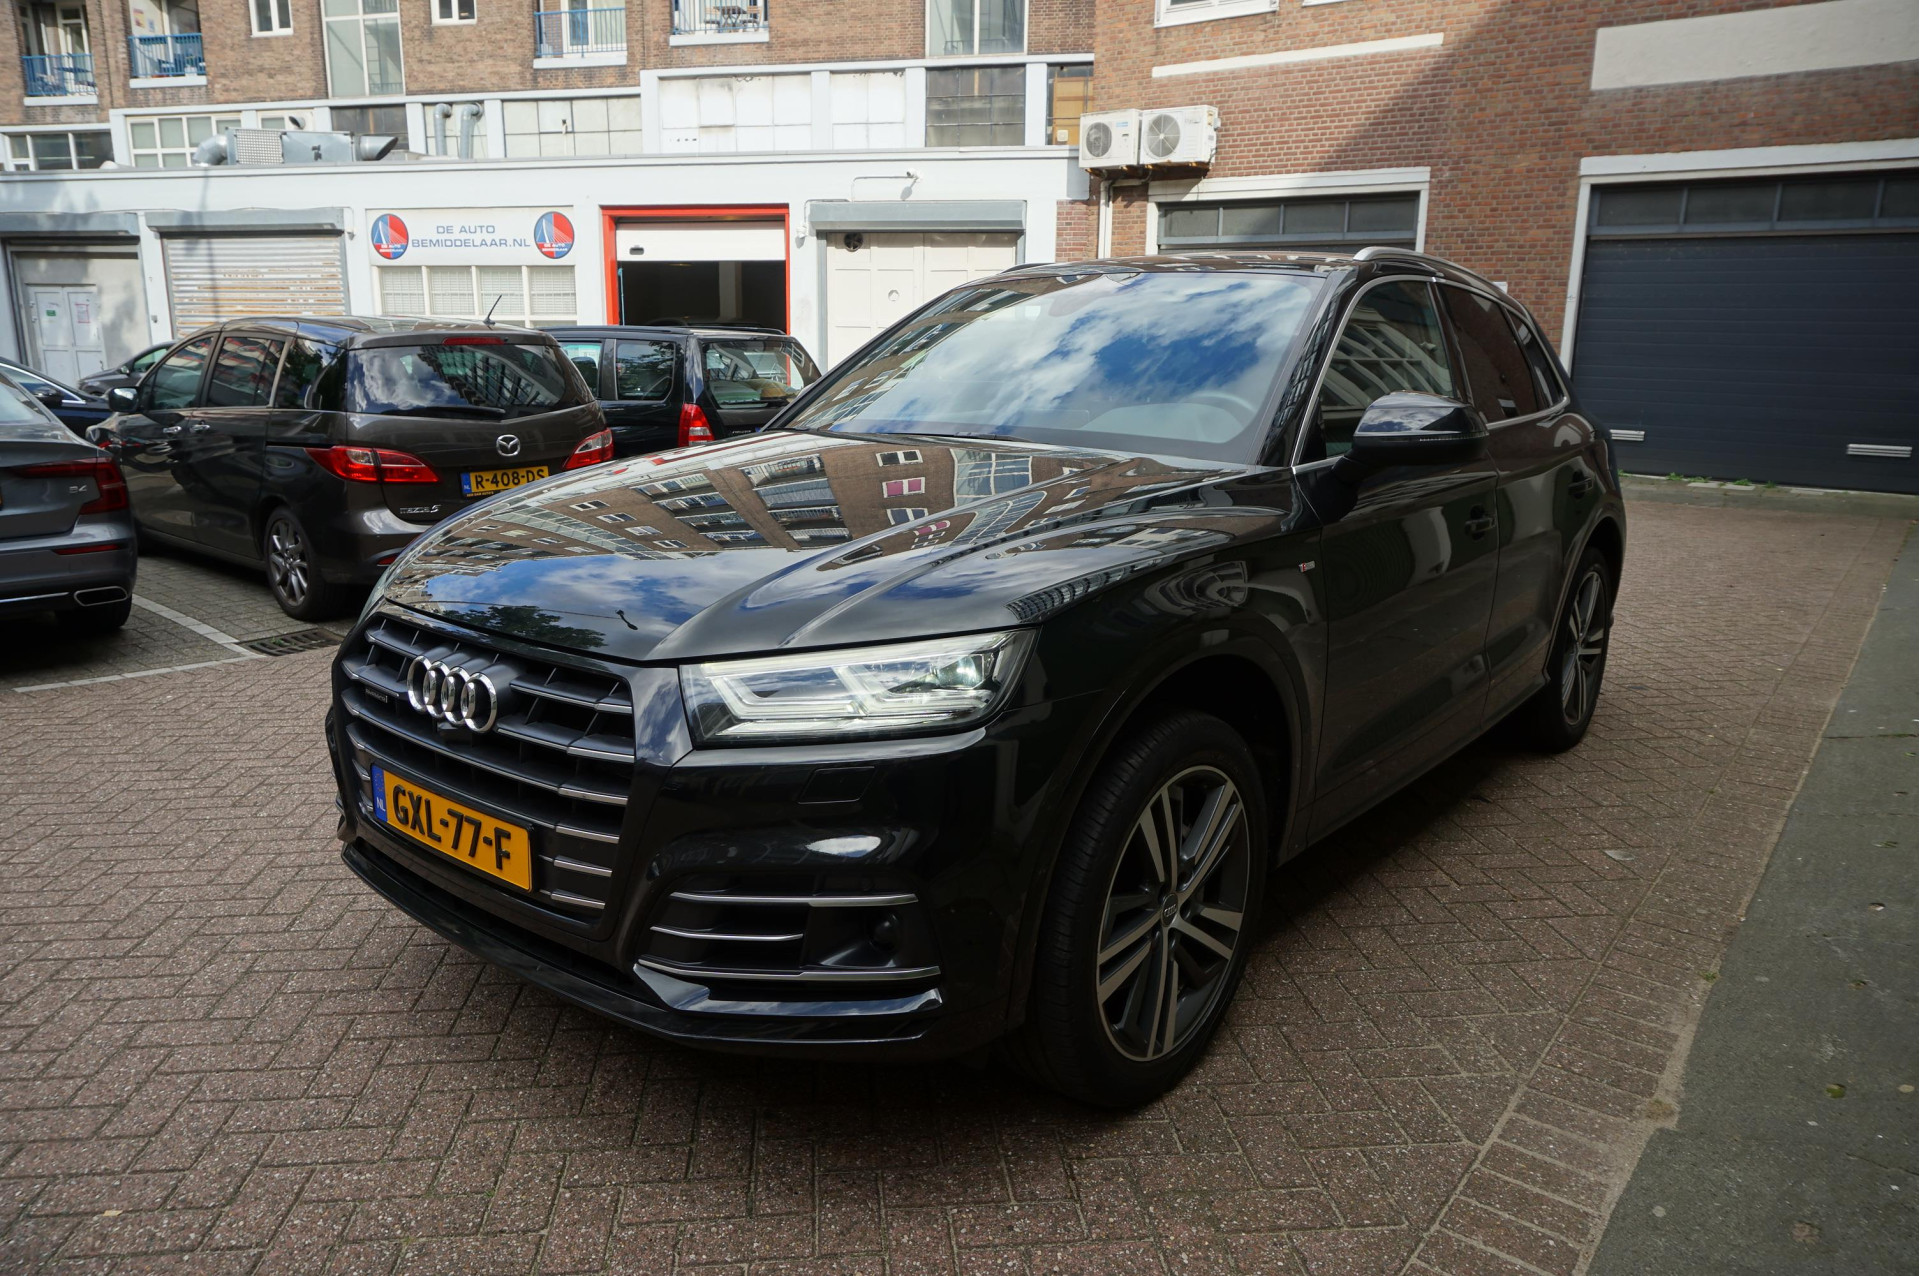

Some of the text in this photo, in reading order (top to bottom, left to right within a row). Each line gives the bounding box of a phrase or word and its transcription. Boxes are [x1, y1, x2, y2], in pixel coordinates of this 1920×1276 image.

[436, 224, 496, 234] DE AUTO
[411, 238, 531, 248] BEMIDDELAAR.NL
[474, 469, 545, 489] R-408-DS
[376, 796, 386, 812] NL
[392, 784, 512, 870] GXL-77-F
